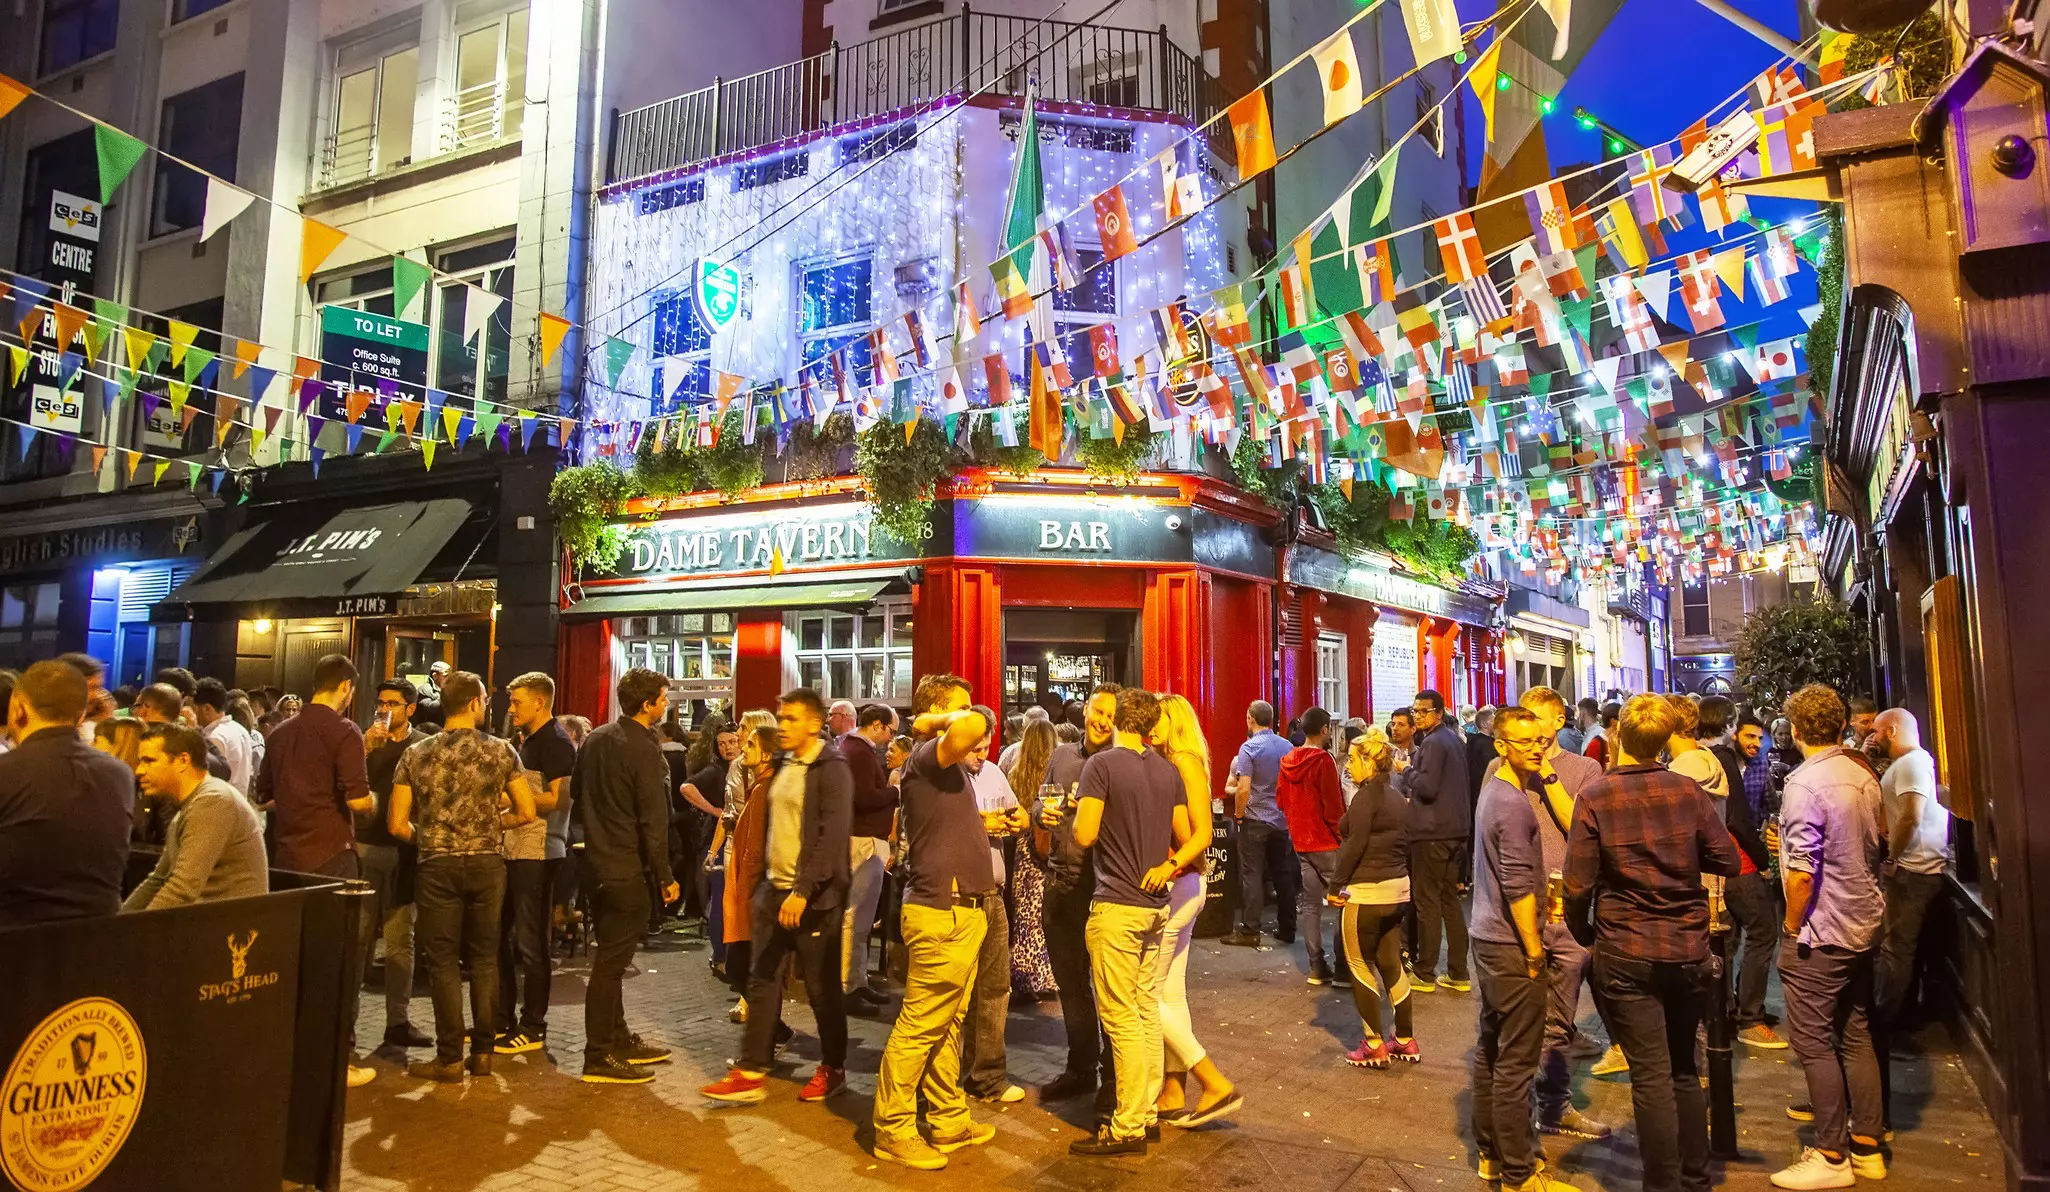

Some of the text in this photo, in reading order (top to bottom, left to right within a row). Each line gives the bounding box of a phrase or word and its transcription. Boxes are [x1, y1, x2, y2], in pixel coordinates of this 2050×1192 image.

[52, 241, 93, 273] CENTRE
[61, 280, 77, 305] OF
[354, 317, 403, 339] TO LET
[353, 348, 401, 366] Office Suite
[362, 362, 379, 374] 600
[59, 529, 143, 558] Studies
[276, 533, 319, 557] J.T.
[630, 530, 723, 571] DAME
[729, 518, 874, 567] TAVERN
[1039, 520, 1112, 550] BAR
[336, 596, 387, 616] J.T. PIM'S
[1206, 847, 1227, 862] LING
[244, 972, 279, 990] HEAD
[21, 1009, 135, 1076] TRADITIONALLY BREWED
[9, 1070, 137, 1116] GUINNESS
[32, 1101, 112, 1126] EXTRA STOUT
[89, 1113, 125, 1166] DUBLIN
